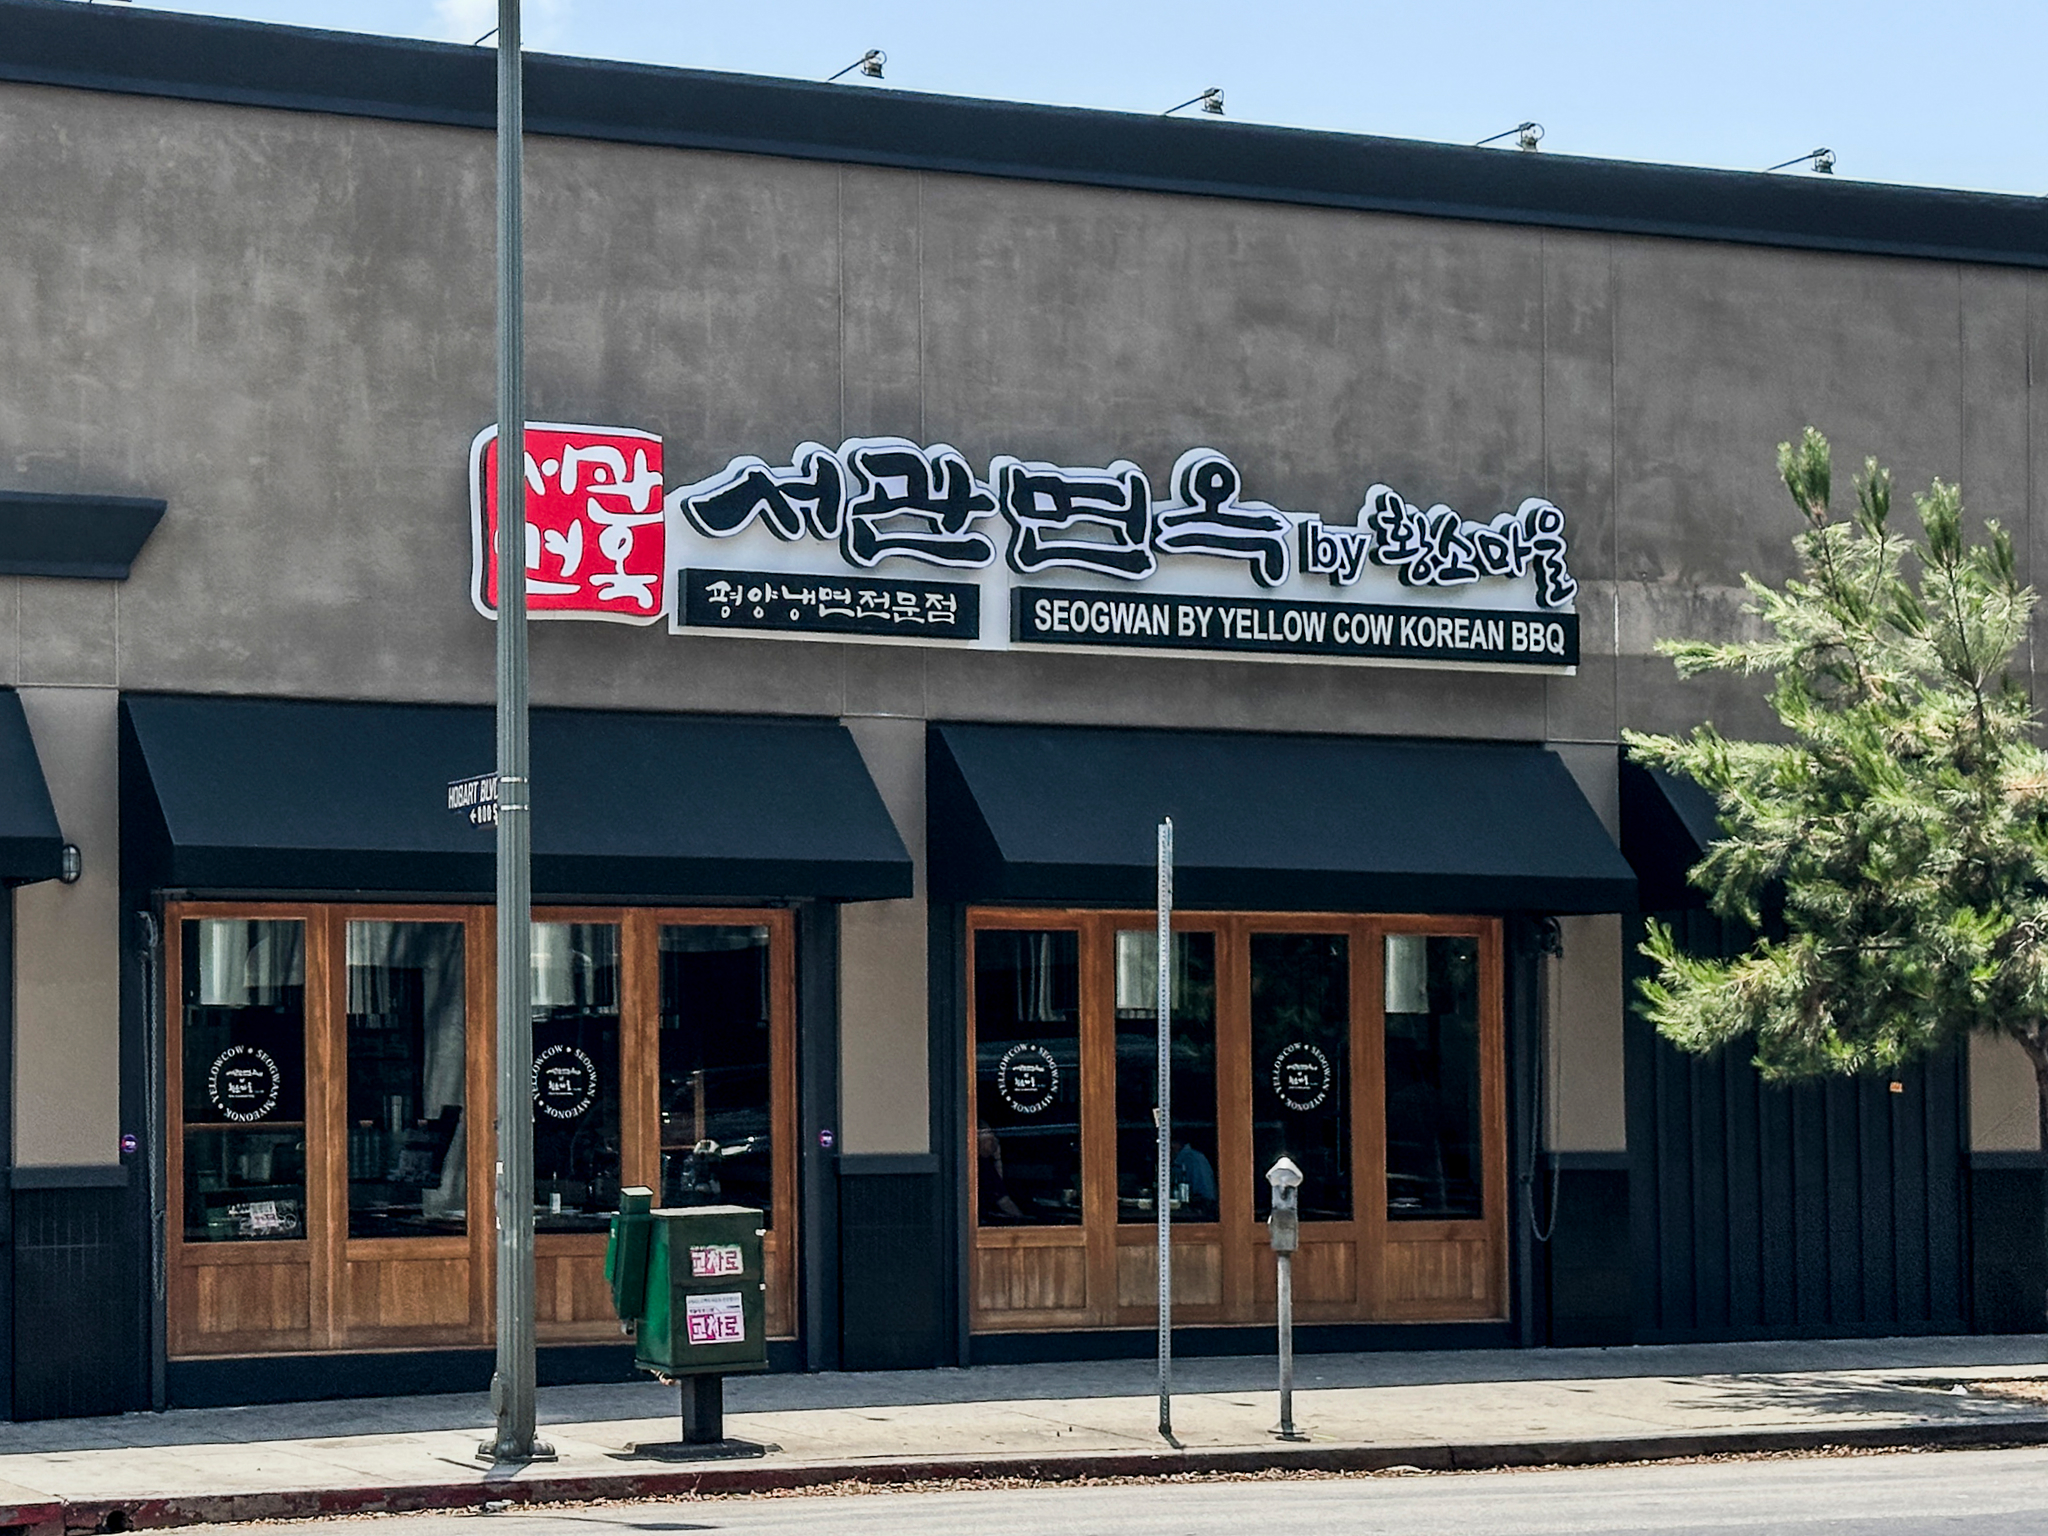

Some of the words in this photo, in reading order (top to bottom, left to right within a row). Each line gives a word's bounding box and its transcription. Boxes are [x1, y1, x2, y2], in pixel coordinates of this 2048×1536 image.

[1304, 519, 1372, 585] by
[705, 580, 957, 624] 평양냉면전문점
[1034, 598, 1170, 636] SEOGWAN
[1178, 605, 1213, 638] BY
[1218, 606, 1326, 643] YELLOW
[1332, 611, 1393, 646] COW
[1400, 615, 1504, 651] KOREAN
[1511, 621, 1565, 656] BBQ
[448, 781, 479, 809] HOBART
